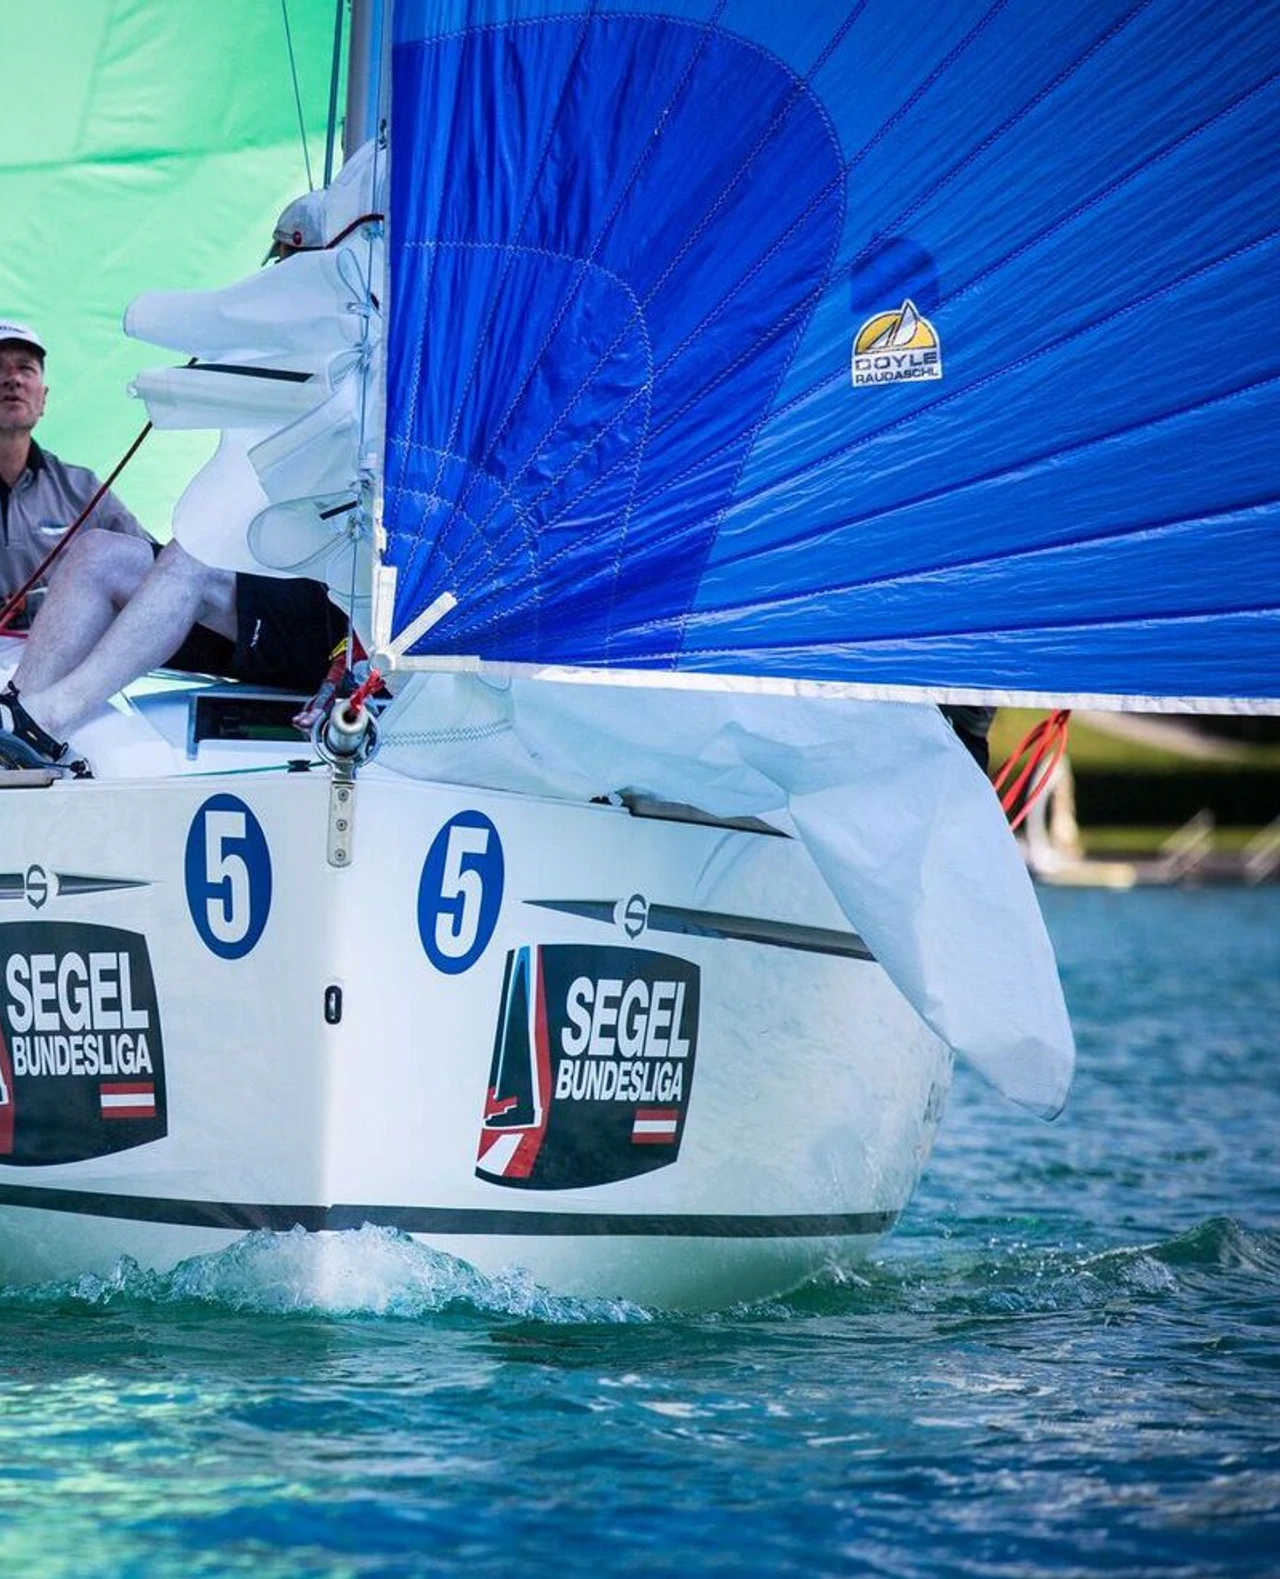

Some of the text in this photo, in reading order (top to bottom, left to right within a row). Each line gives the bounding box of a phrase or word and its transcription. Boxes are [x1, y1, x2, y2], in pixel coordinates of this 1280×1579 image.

[855, 352, 938, 371] DOYLE
[855, 368, 939, 384] RAUDASCHL
[205, 811, 251, 943] 5
[434, 825, 490, 959] 5
[6, 952, 150, 1033] SEGEL
[561, 976, 691, 1058] SEGEL
[11, 1033, 153, 1077] BUNDESLIGA
[555, 1059, 684, 1102] BUNDESLIGA
